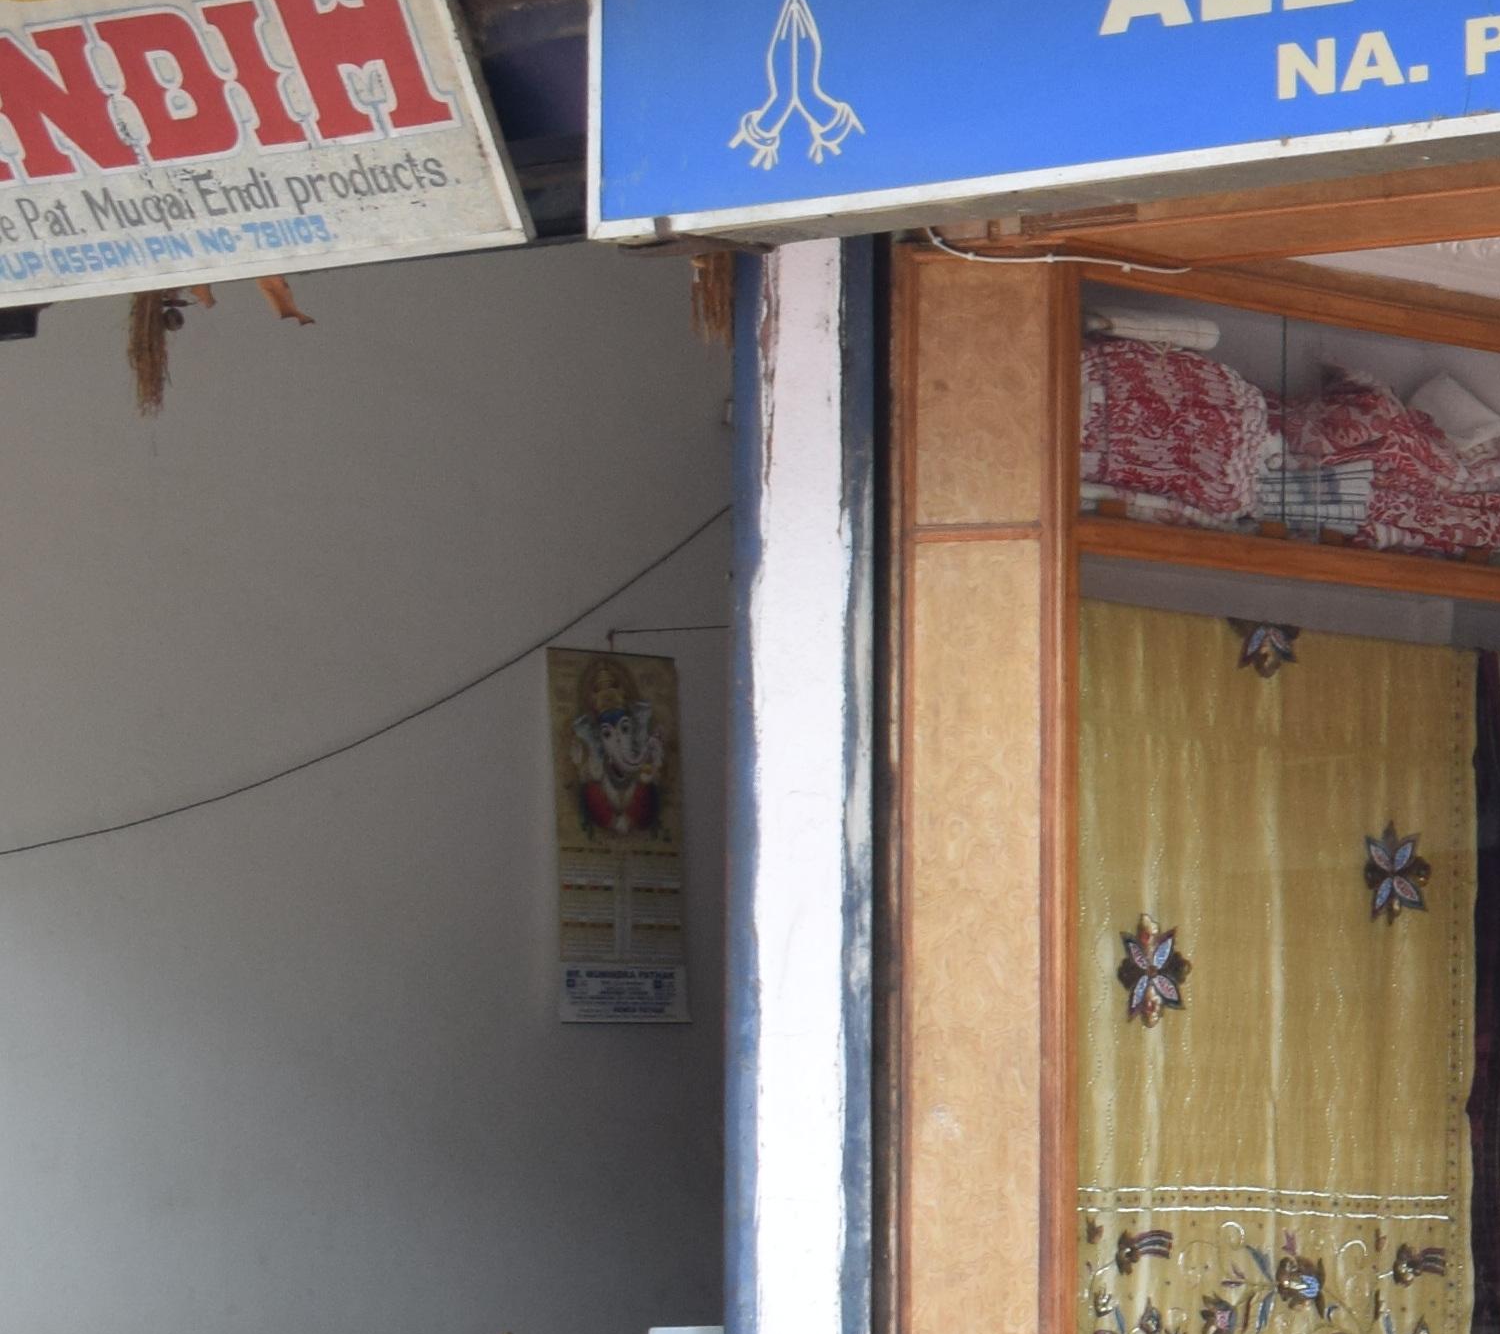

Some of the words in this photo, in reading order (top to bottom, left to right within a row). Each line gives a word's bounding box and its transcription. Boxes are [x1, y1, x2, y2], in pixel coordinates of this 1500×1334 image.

[1277, 31, 1429, 100] NA.
[192, 167, 280, 216] Endi
[145, 234, 194, 263] PIN
